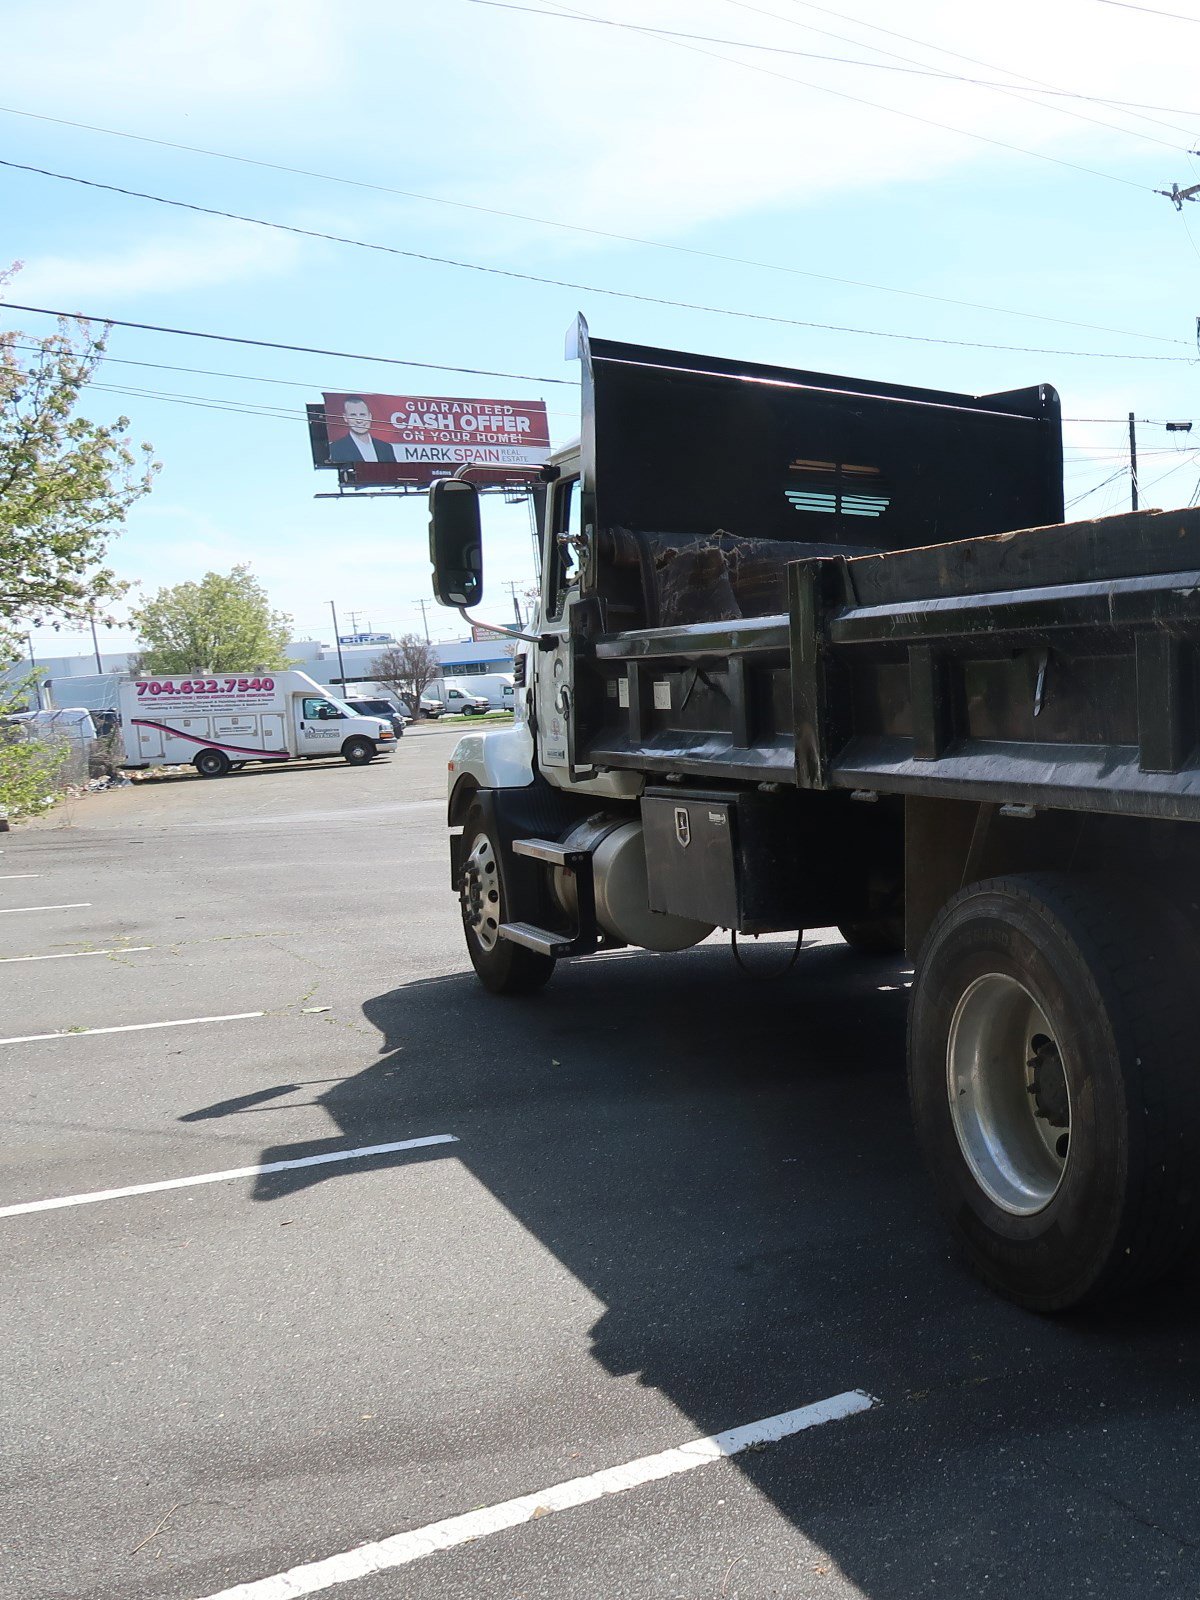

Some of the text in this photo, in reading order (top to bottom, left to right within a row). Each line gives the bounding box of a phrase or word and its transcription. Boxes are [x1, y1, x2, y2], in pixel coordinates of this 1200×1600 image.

[406, 401, 514, 415] GUARANTEED
[390, 412, 531, 433] CASH OFFER
[403, 430, 523, 444] ON YOUR HOME!
[405, 447, 452, 461] MARK
[453, 448, 500, 463] SPAIN
[501, 455, 529, 463] ESTATE
[135, 677, 275, 696] 704.622.7540
